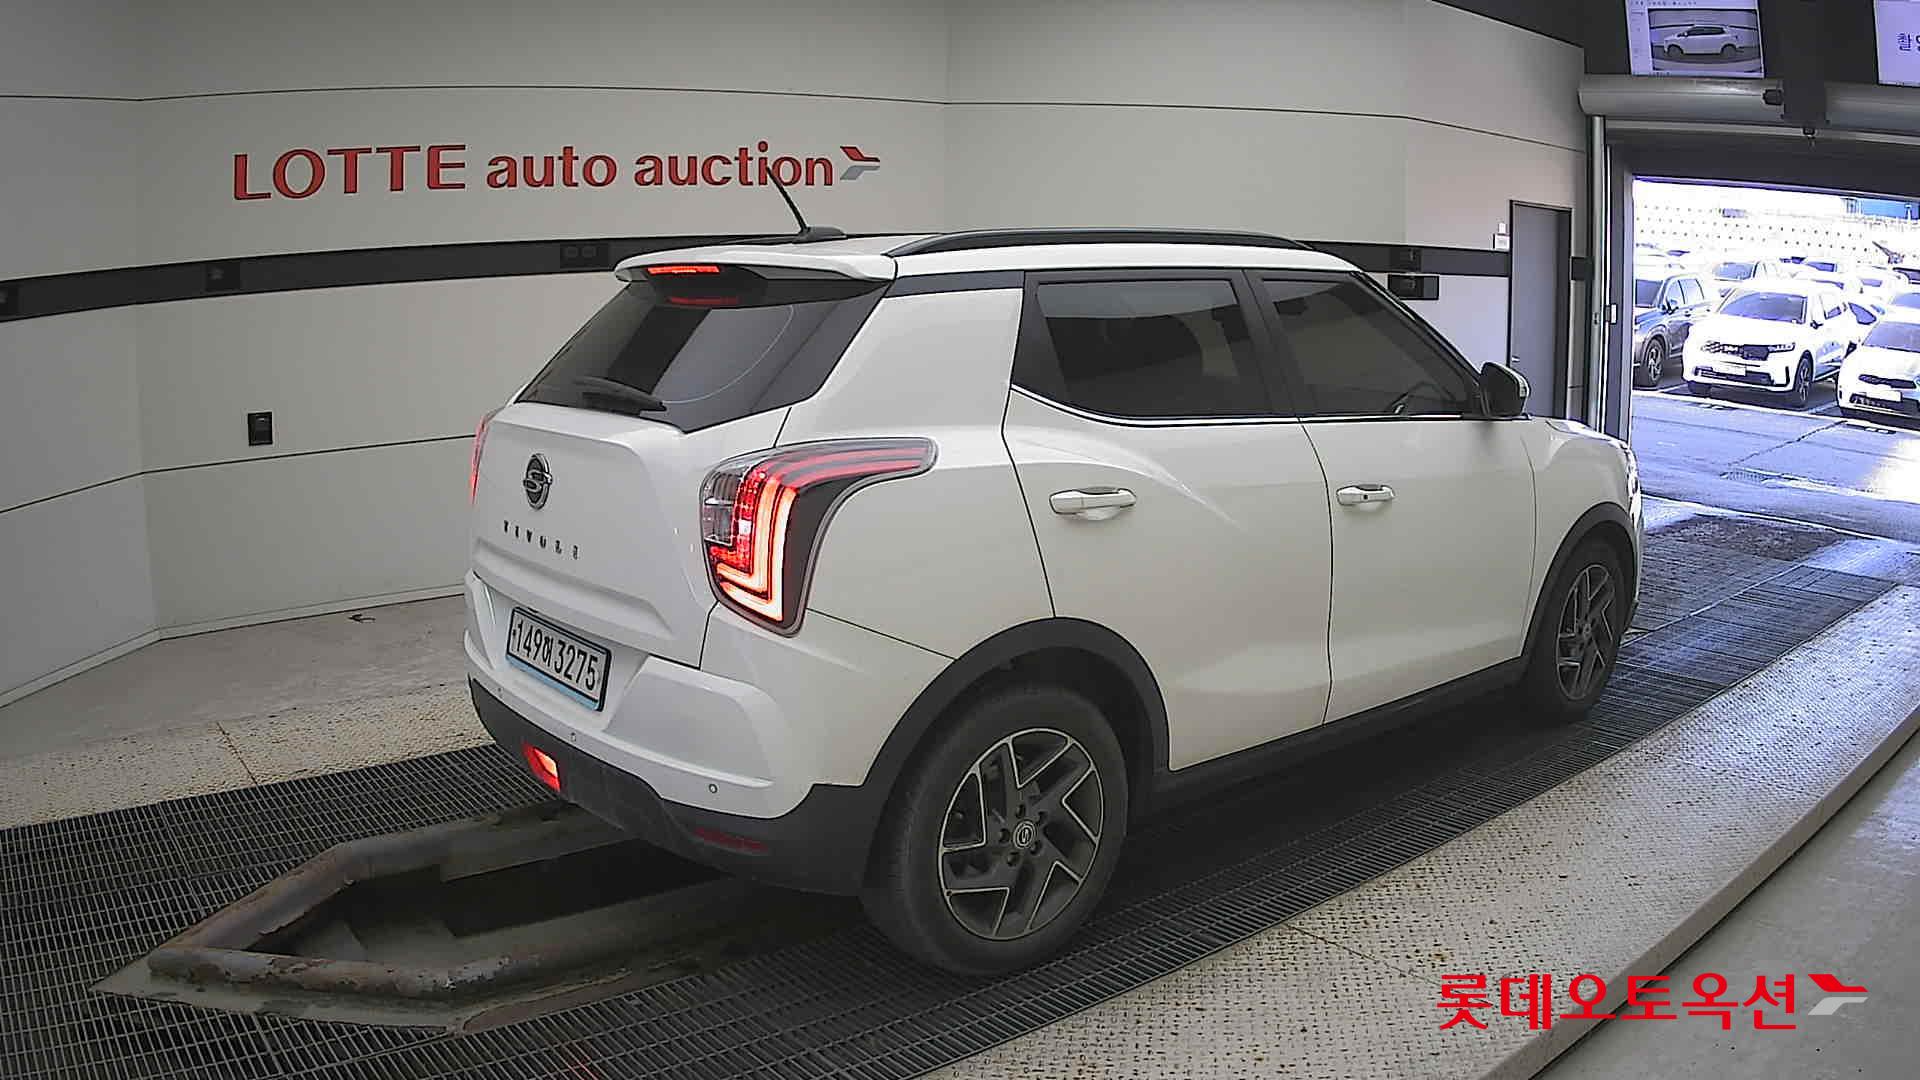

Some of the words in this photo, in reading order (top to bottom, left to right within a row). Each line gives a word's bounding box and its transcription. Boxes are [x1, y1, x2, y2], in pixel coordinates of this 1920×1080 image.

[234, 144, 466, 201] LOTTE
[486, 146, 617, 189] auto
[634, 141, 834, 188] auction
[554, 639, 598, 691] 3275
